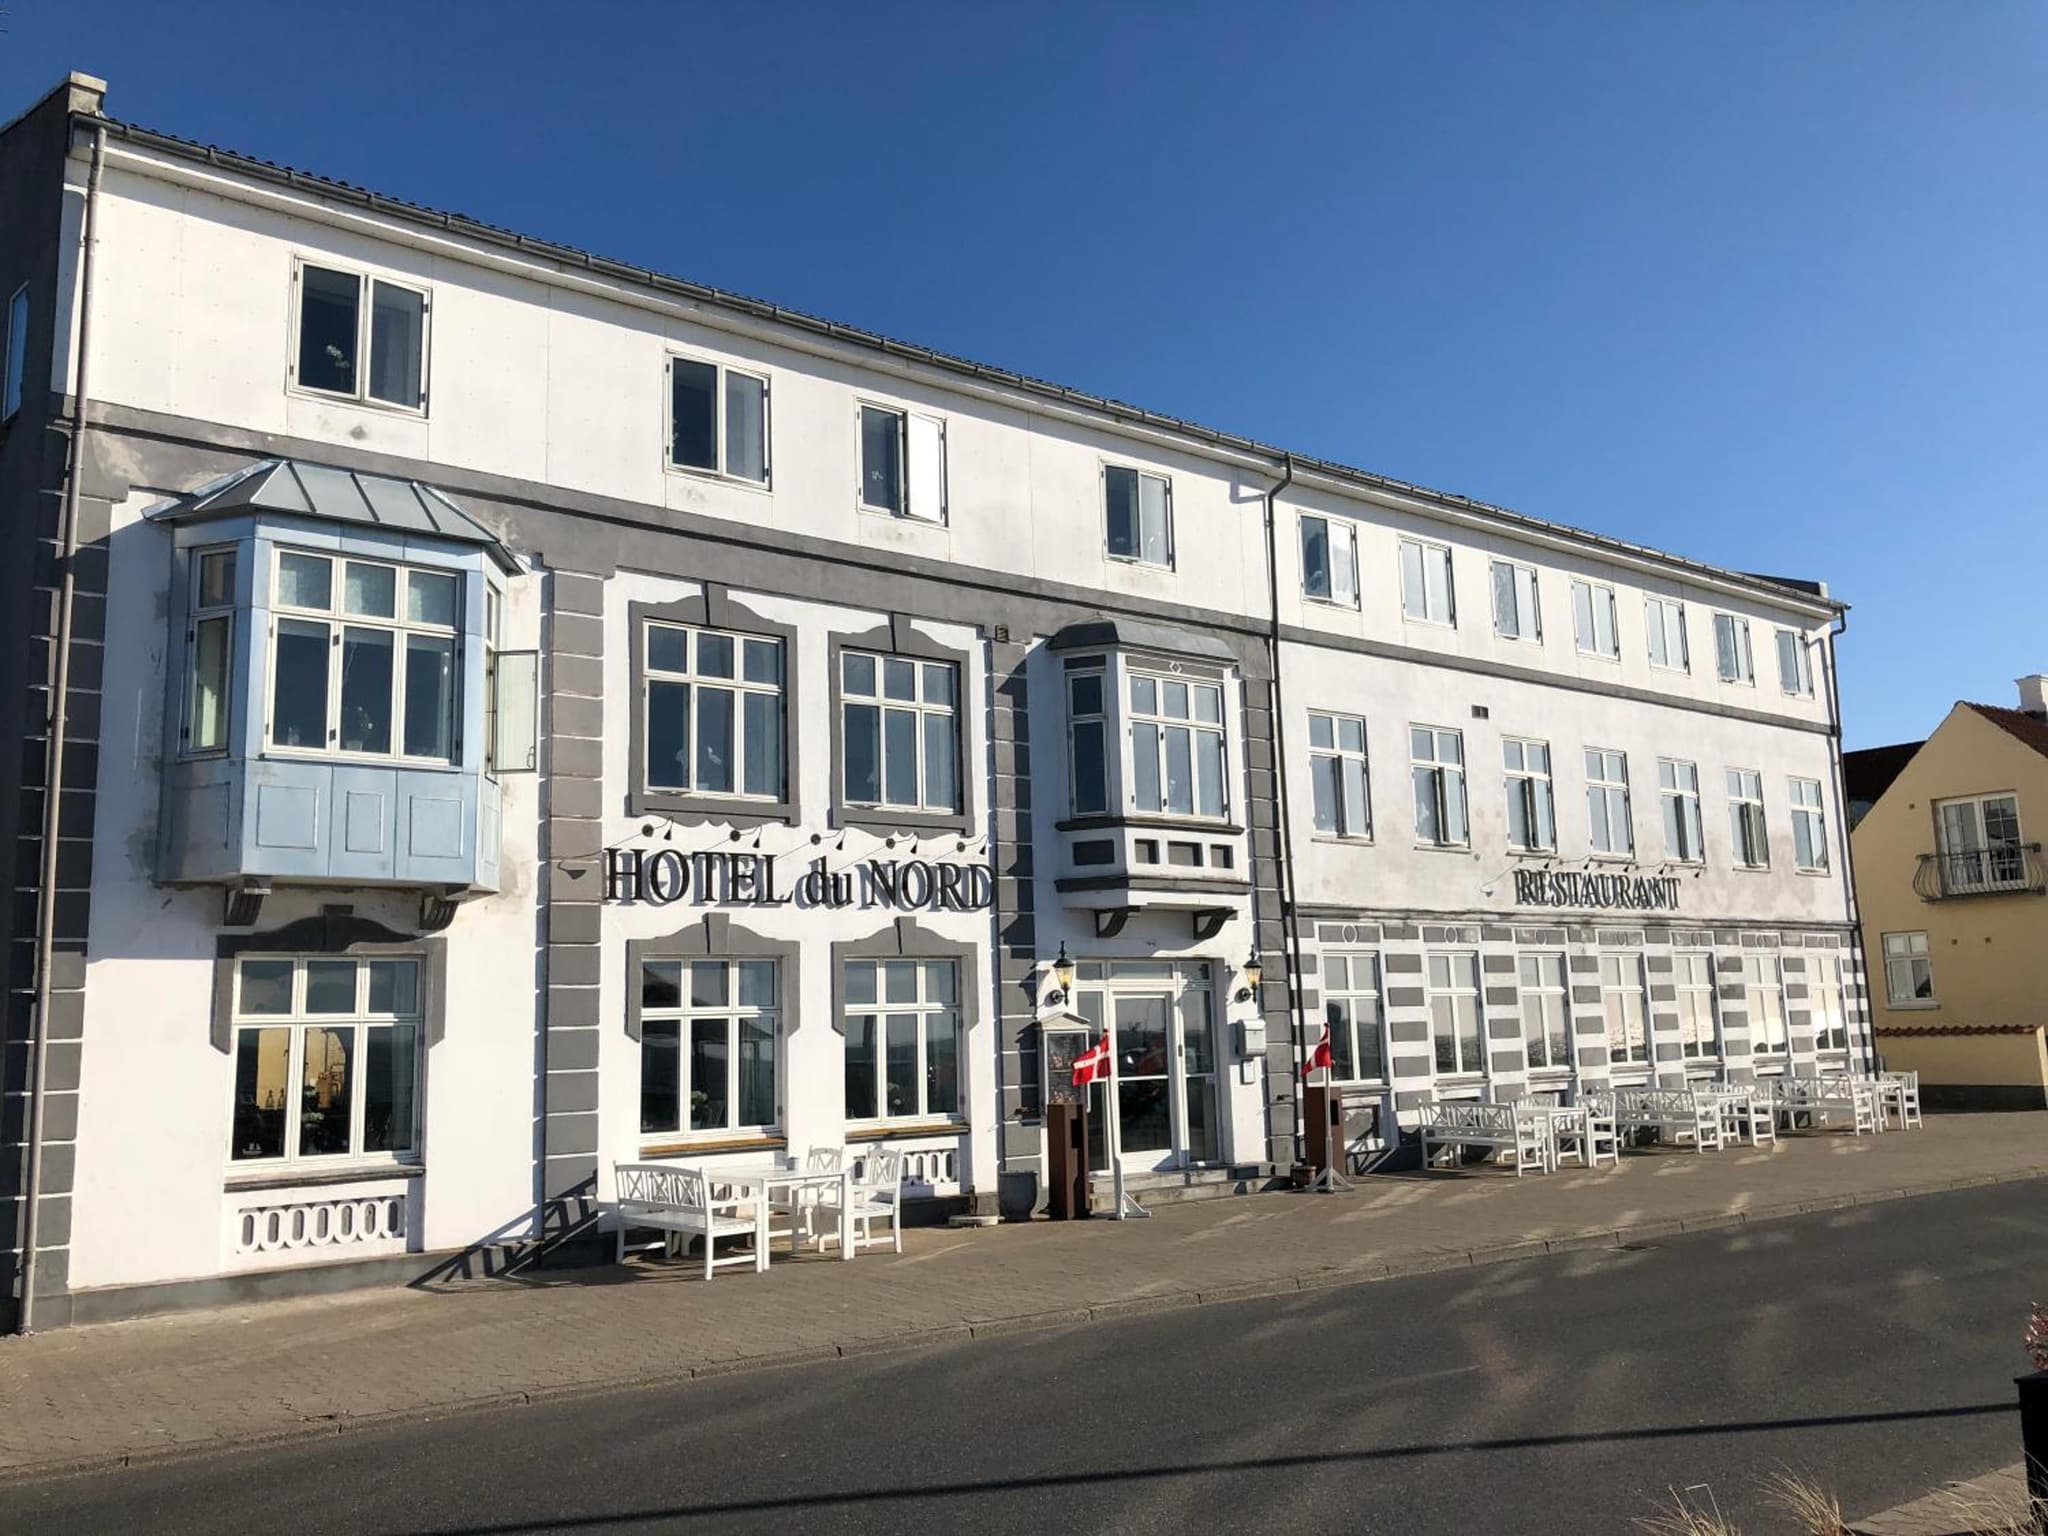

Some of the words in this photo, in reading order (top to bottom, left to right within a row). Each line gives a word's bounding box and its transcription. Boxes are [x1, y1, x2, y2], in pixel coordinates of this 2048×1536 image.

[604, 847, 793, 903] HOTEL
[805, 856, 852, 905] du
[866, 859, 997, 908] NORD
[1514, 869, 1681, 910] RESTAURANT
